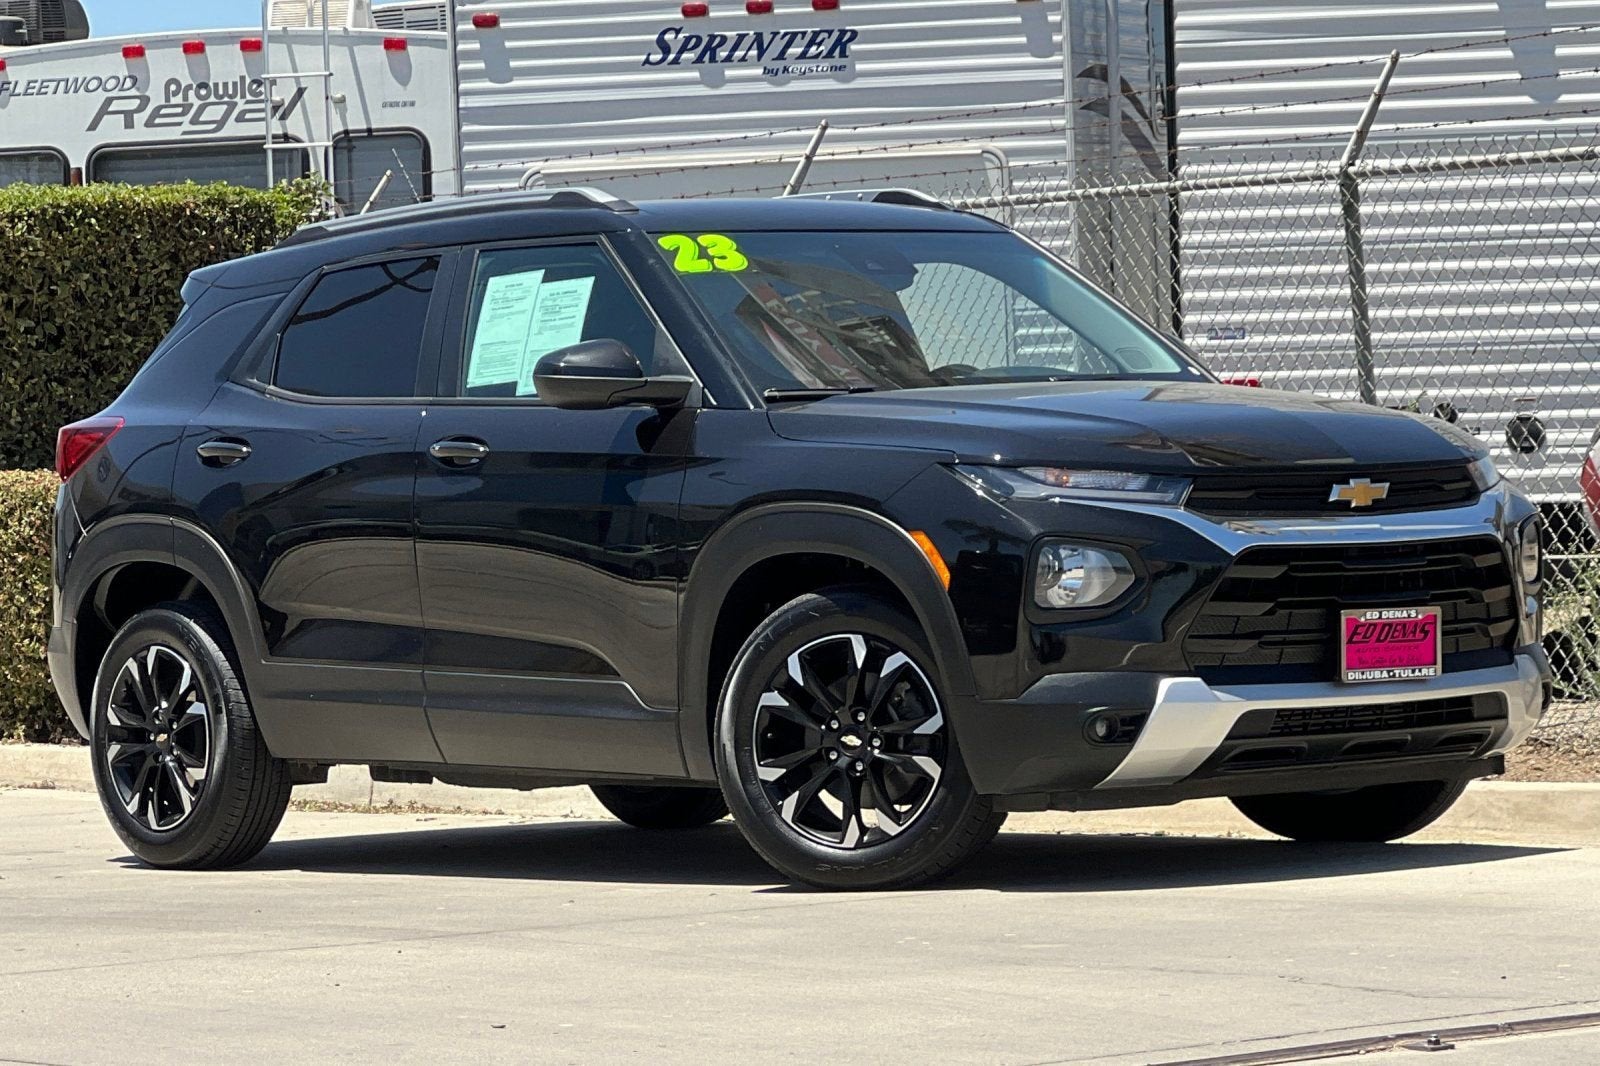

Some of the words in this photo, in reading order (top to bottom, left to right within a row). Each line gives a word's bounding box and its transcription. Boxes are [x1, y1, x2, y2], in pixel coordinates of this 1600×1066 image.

[641, 26, 858, 67] SPRINTER
[762, 65, 779, 77] by
[782, 64, 847, 76] Keystone
[0, 75, 138, 97] FLEETWOOD
[85, 87, 308, 136] Regal
[657, 234, 749, 273] 23
[1366, 611, 1379, 620] ED
[1382, 609, 1417, 619] DENA'S
[1346, 622, 1378, 644] ED
